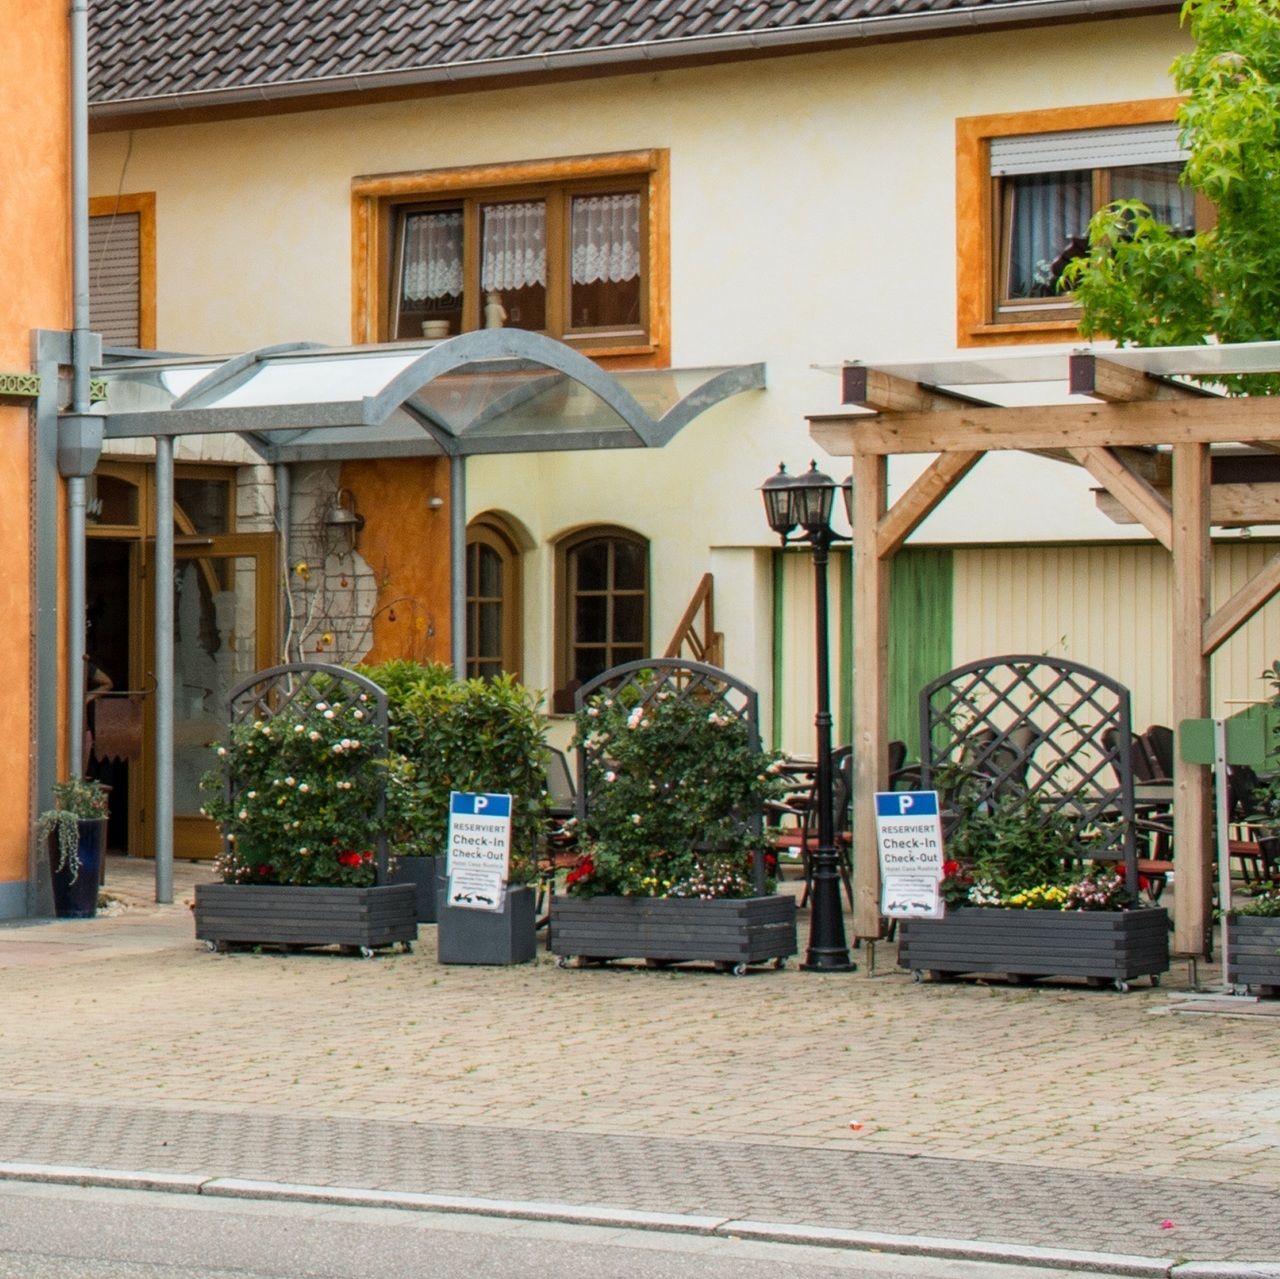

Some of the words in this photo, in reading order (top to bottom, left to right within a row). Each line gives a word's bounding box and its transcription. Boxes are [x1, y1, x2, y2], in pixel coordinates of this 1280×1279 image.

[473, 796, 488, 814] P
[899, 795, 914, 815] P
[453, 822, 505, 832] RESERVIERT
[881, 824, 935, 834] RESERVIERT
[453, 834, 505, 847] Check-In
[883, 837, 937, 849] Check-In
[452, 848, 504, 860] Check-Out
[884, 852, 938, 863] Check-Out
